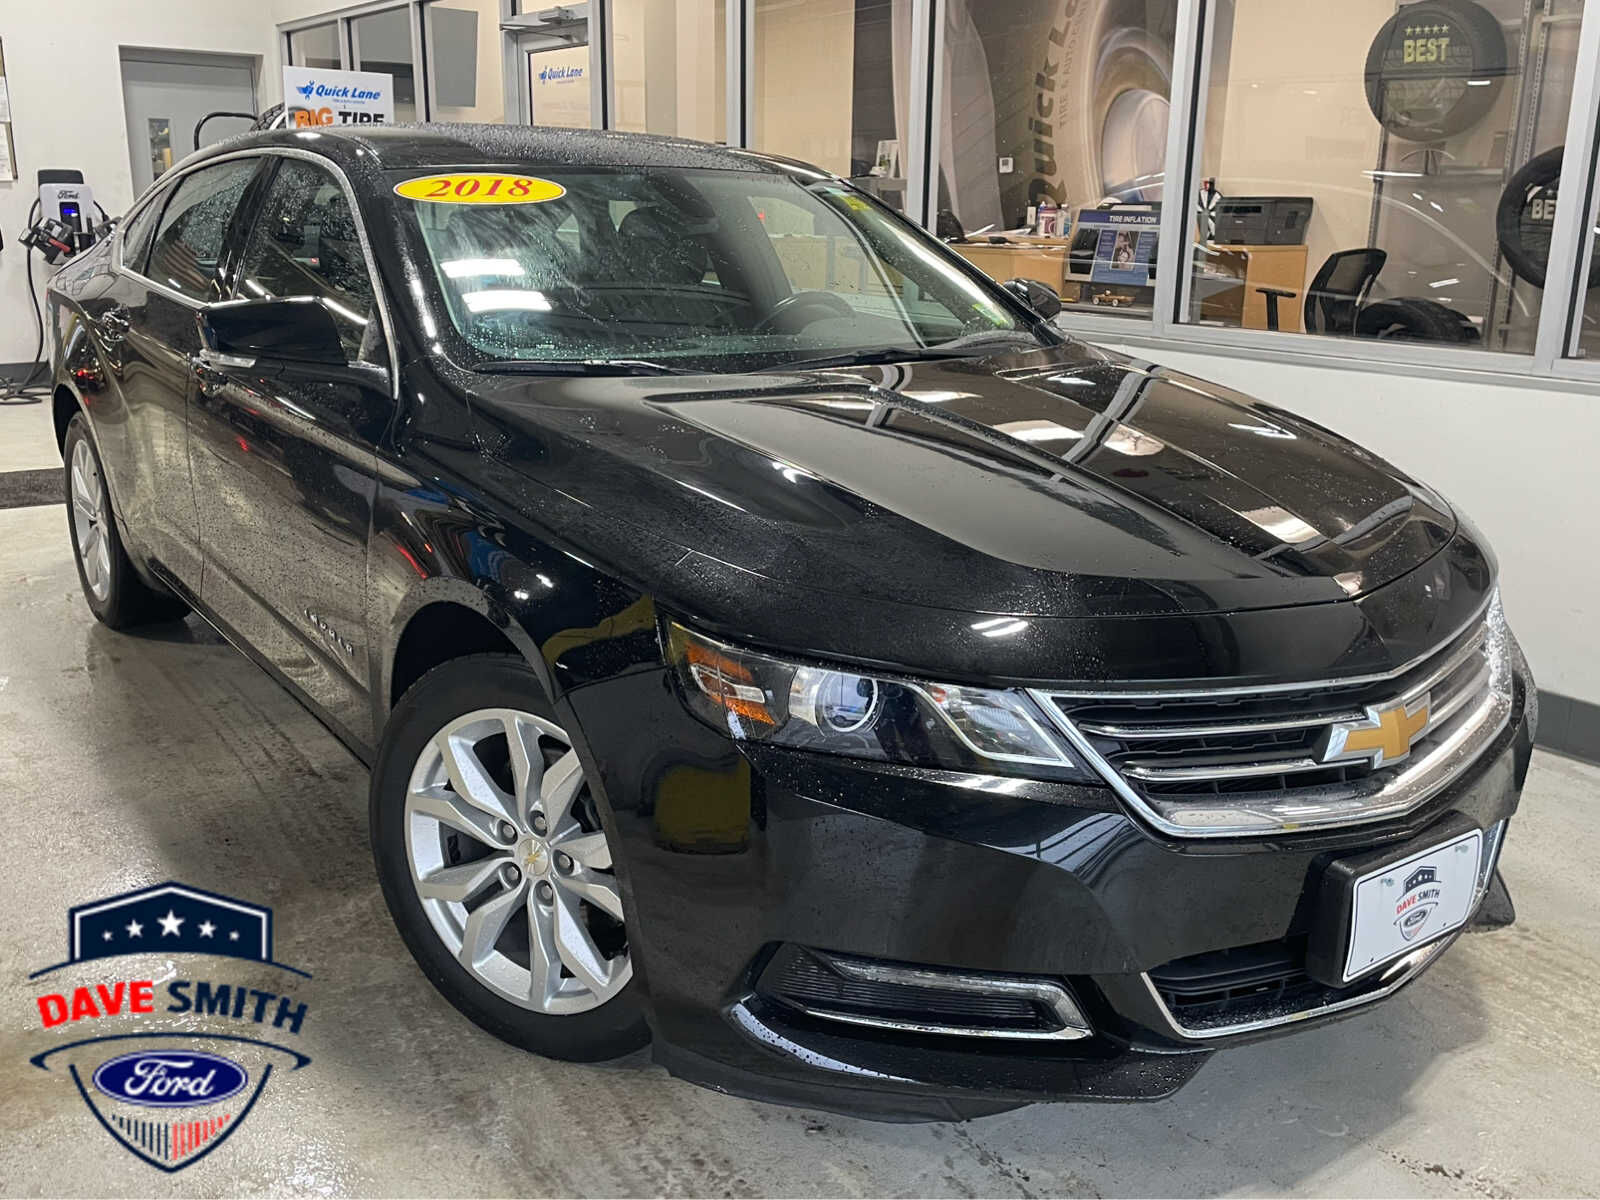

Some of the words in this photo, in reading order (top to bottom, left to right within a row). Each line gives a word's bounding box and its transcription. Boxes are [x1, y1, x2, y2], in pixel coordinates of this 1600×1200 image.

[1403, 37, 1450, 64] BEST
[566, 66, 583, 78] Lane
[315, 84, 349, 98] Quick
[351, 87, 381, 100] Lane
[294, 106, 334, 128] BIG
[57, 189, 80, 199] Ford
[426, 178, 533, 198] 2018
[1109, 215, 1122, 223] TIRE
[1123, 215, 1157, 224] INFLATION
[1532, 199, 1557, 220] BE
[1396, 894, 1417, 915] DAVE
[1417, 888, 1441, 902] SMITH
